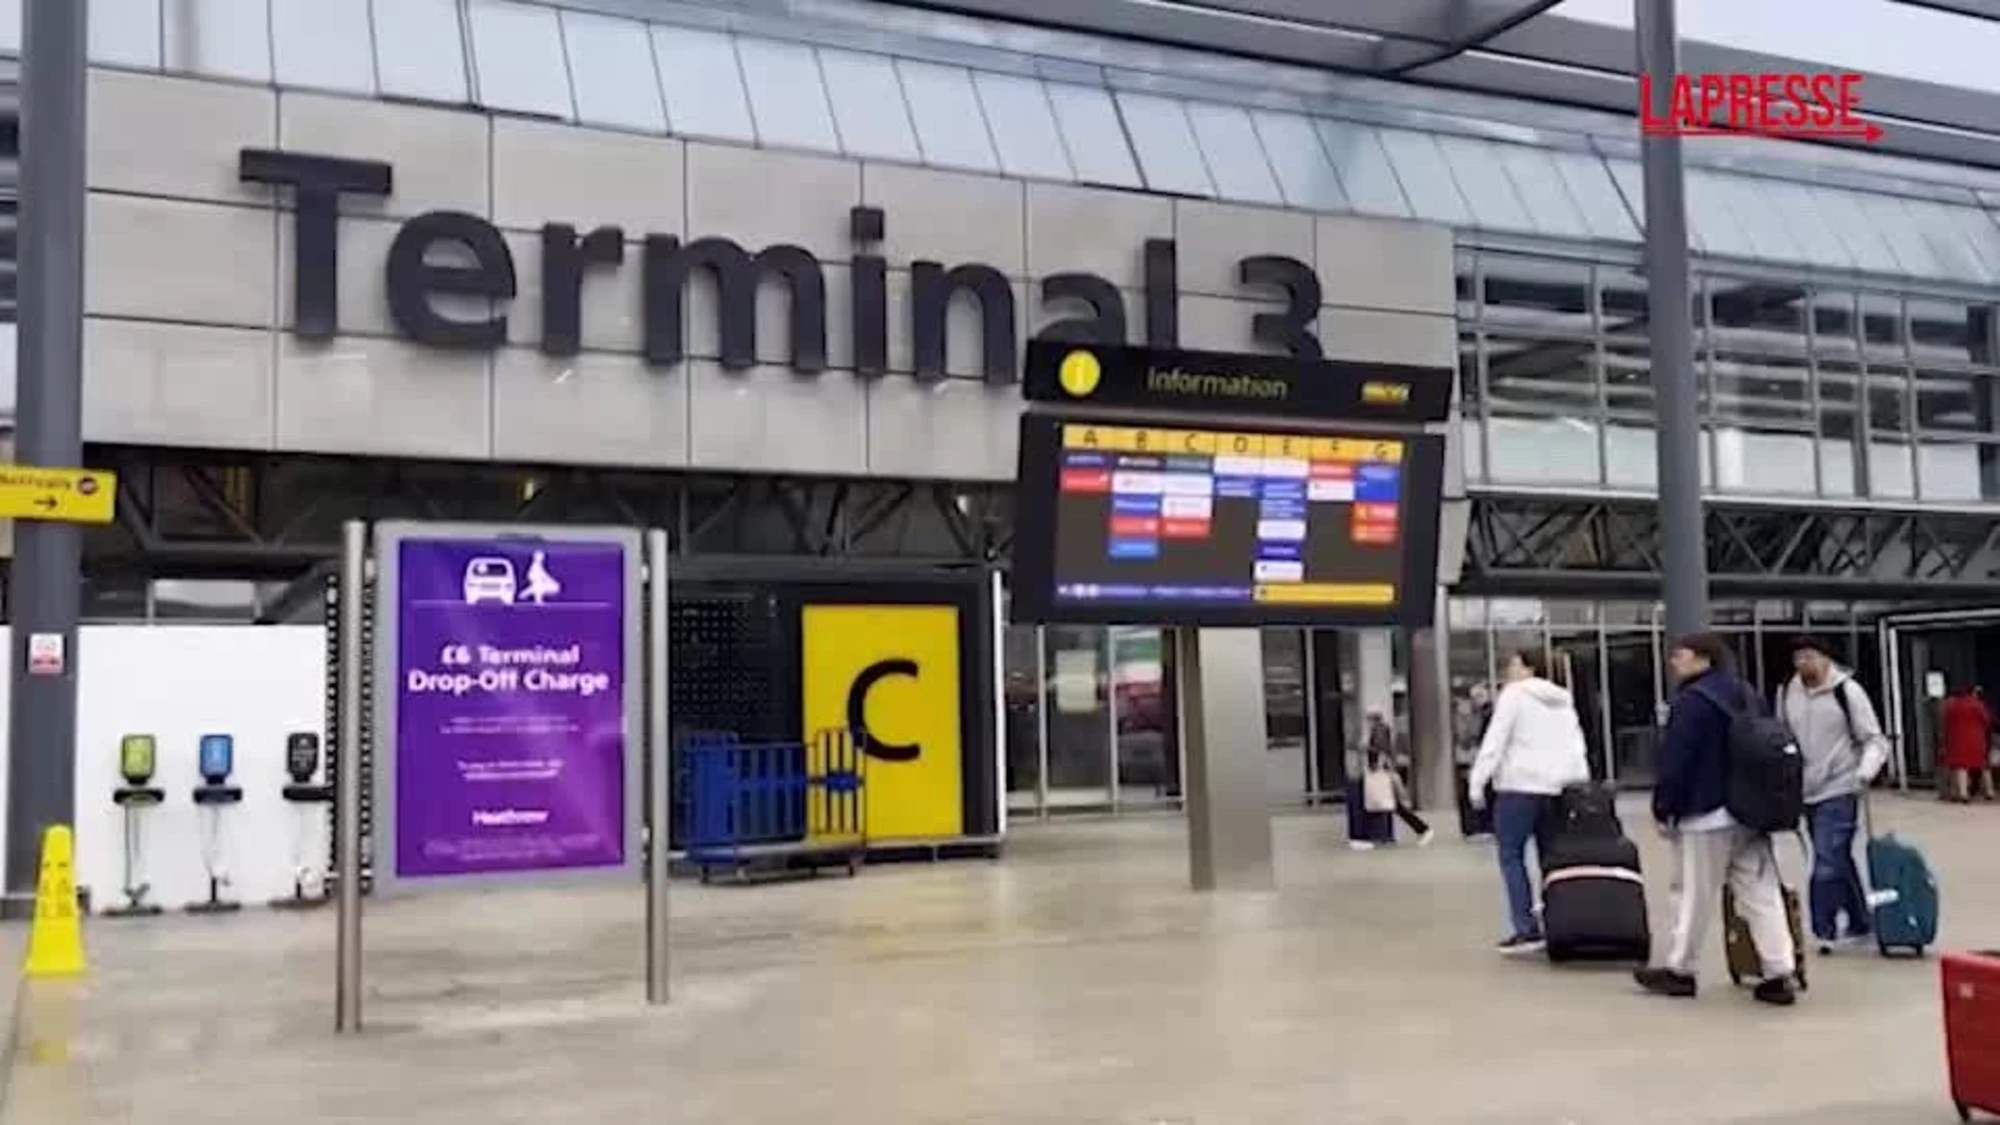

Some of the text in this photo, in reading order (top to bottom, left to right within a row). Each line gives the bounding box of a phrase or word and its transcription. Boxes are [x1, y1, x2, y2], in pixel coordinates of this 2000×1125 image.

[239, 149, 1324, 383] Terminal 3
[1147, 365, 1289, 399] Information
[1083, 428, 1098, 445] A
[1135, 431, 1148, 449] B
[1184, 433, 1197, 451] C
[442, 645, 580, 664] £6 Terminal
[408, 669, 609, 696] Drop-Off Charge
[847, 659, 919, 761] C
